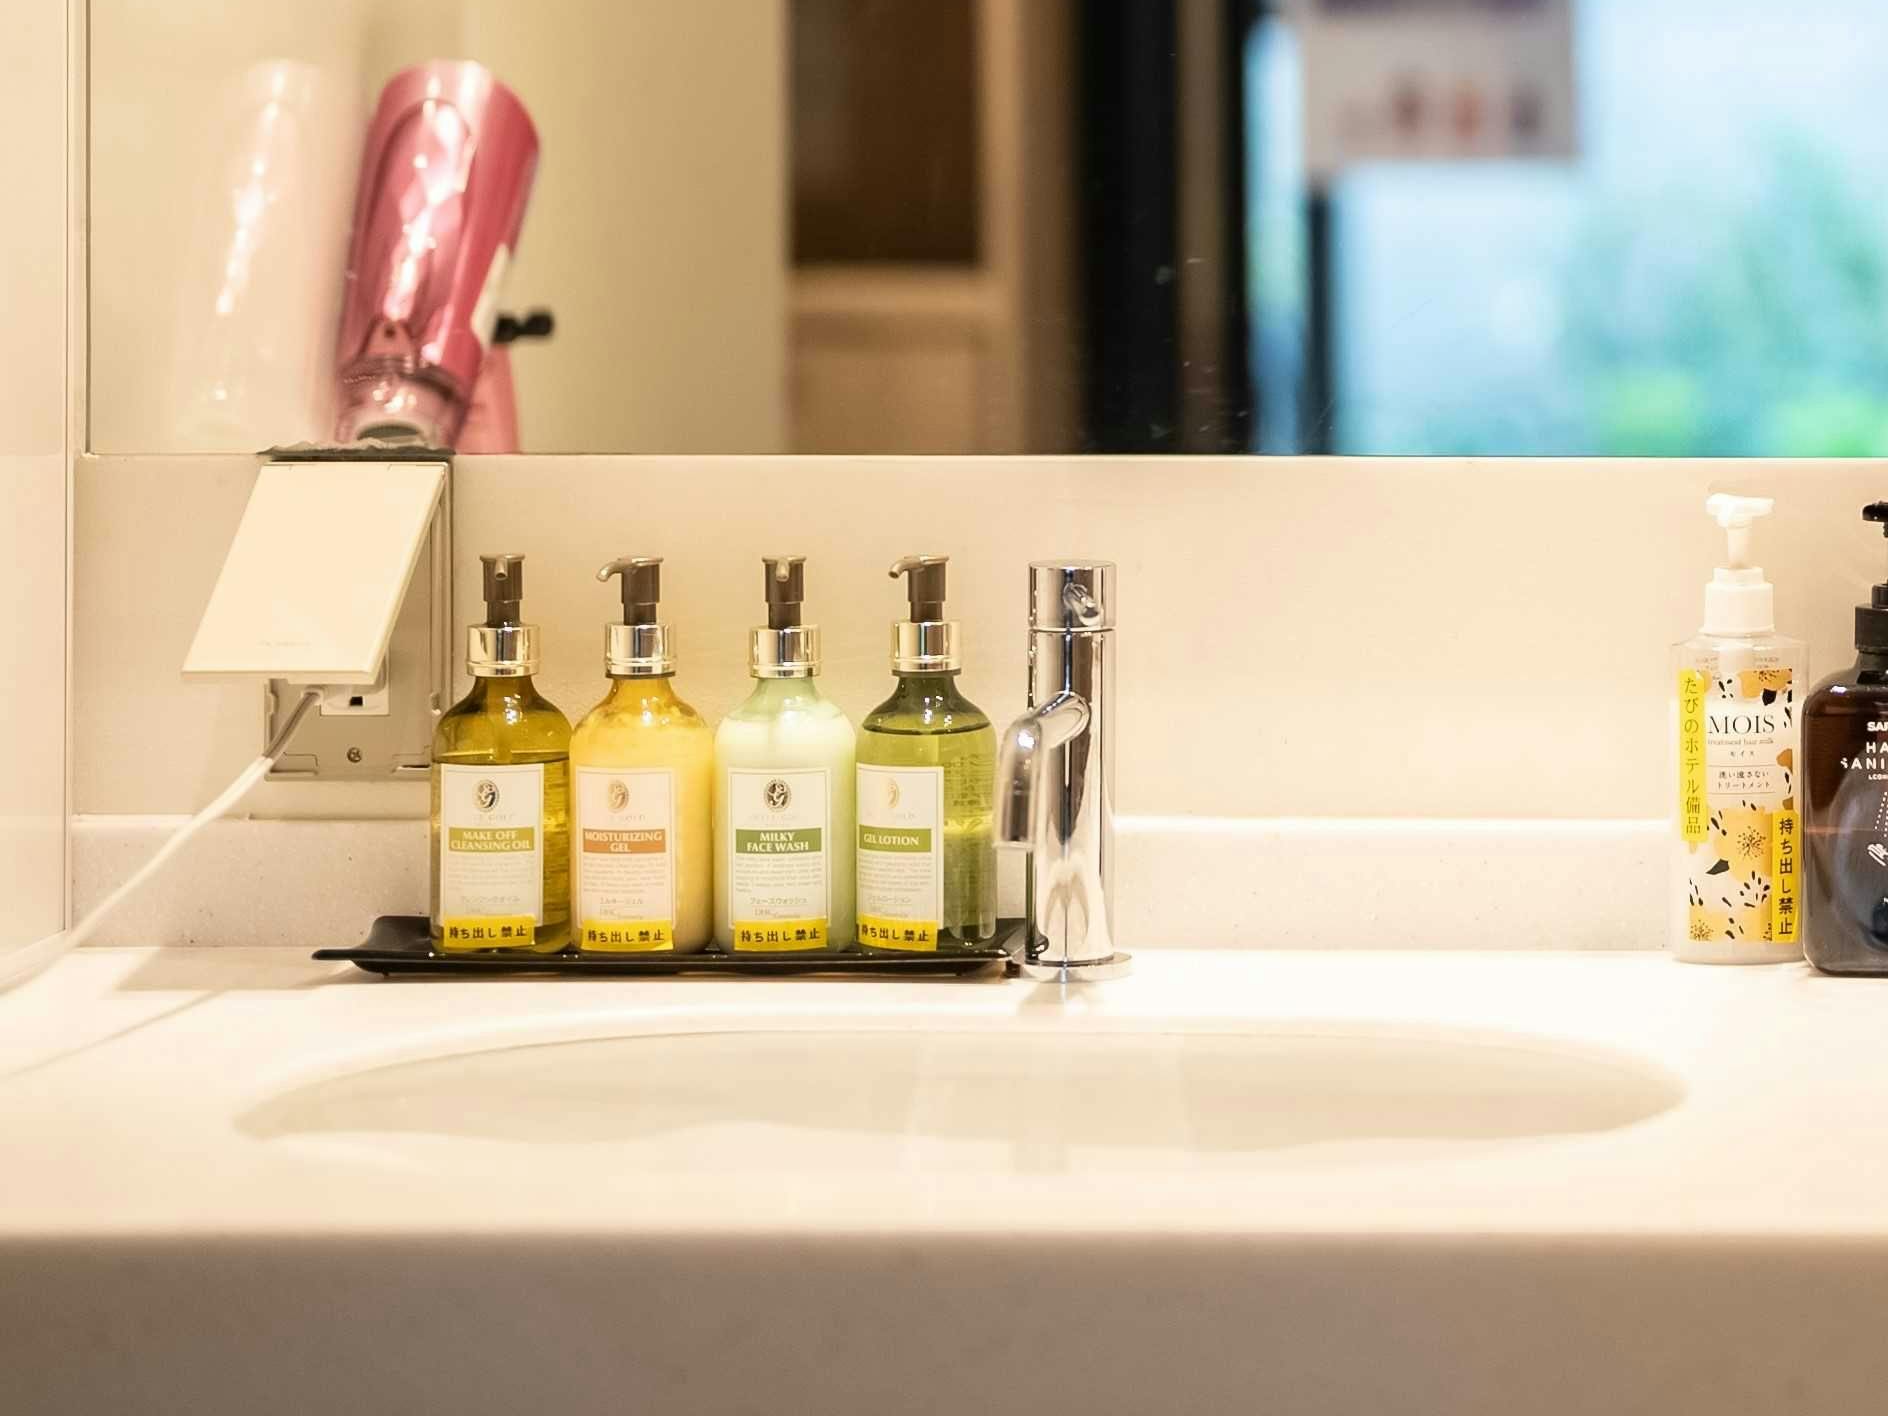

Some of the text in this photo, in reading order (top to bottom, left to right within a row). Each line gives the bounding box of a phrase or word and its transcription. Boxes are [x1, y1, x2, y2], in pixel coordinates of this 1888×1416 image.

[1708, 715, 1775, 734] MOIS
[1684, 677, 1701, 834] たびのホテル備品
[1718, 781, 1770, 789] トリートメント
[463, 830, 519, 841] MAKE OFF
[584, 831, 663, 842] MOISTURIZING
[759, 831, 796, 842] MILKY
[863, 833, 919, 846] GEL LOTION
[451, 840, 531, 851] CLEANSING OIL
[609, 842, 631, 853] GEL
[746, 841, 809, 852] FACE WASH
[1778, 817, 1794, 935] 持ち出し禁止
[448, 924, 527, 940] 持ち出し禁止
[588, 929, 665, 943] 持ち出し禁止
[741, 927, 820, 942] 持ち出し禁止
[861, 924, 929, 942] 持ち出し禁止
